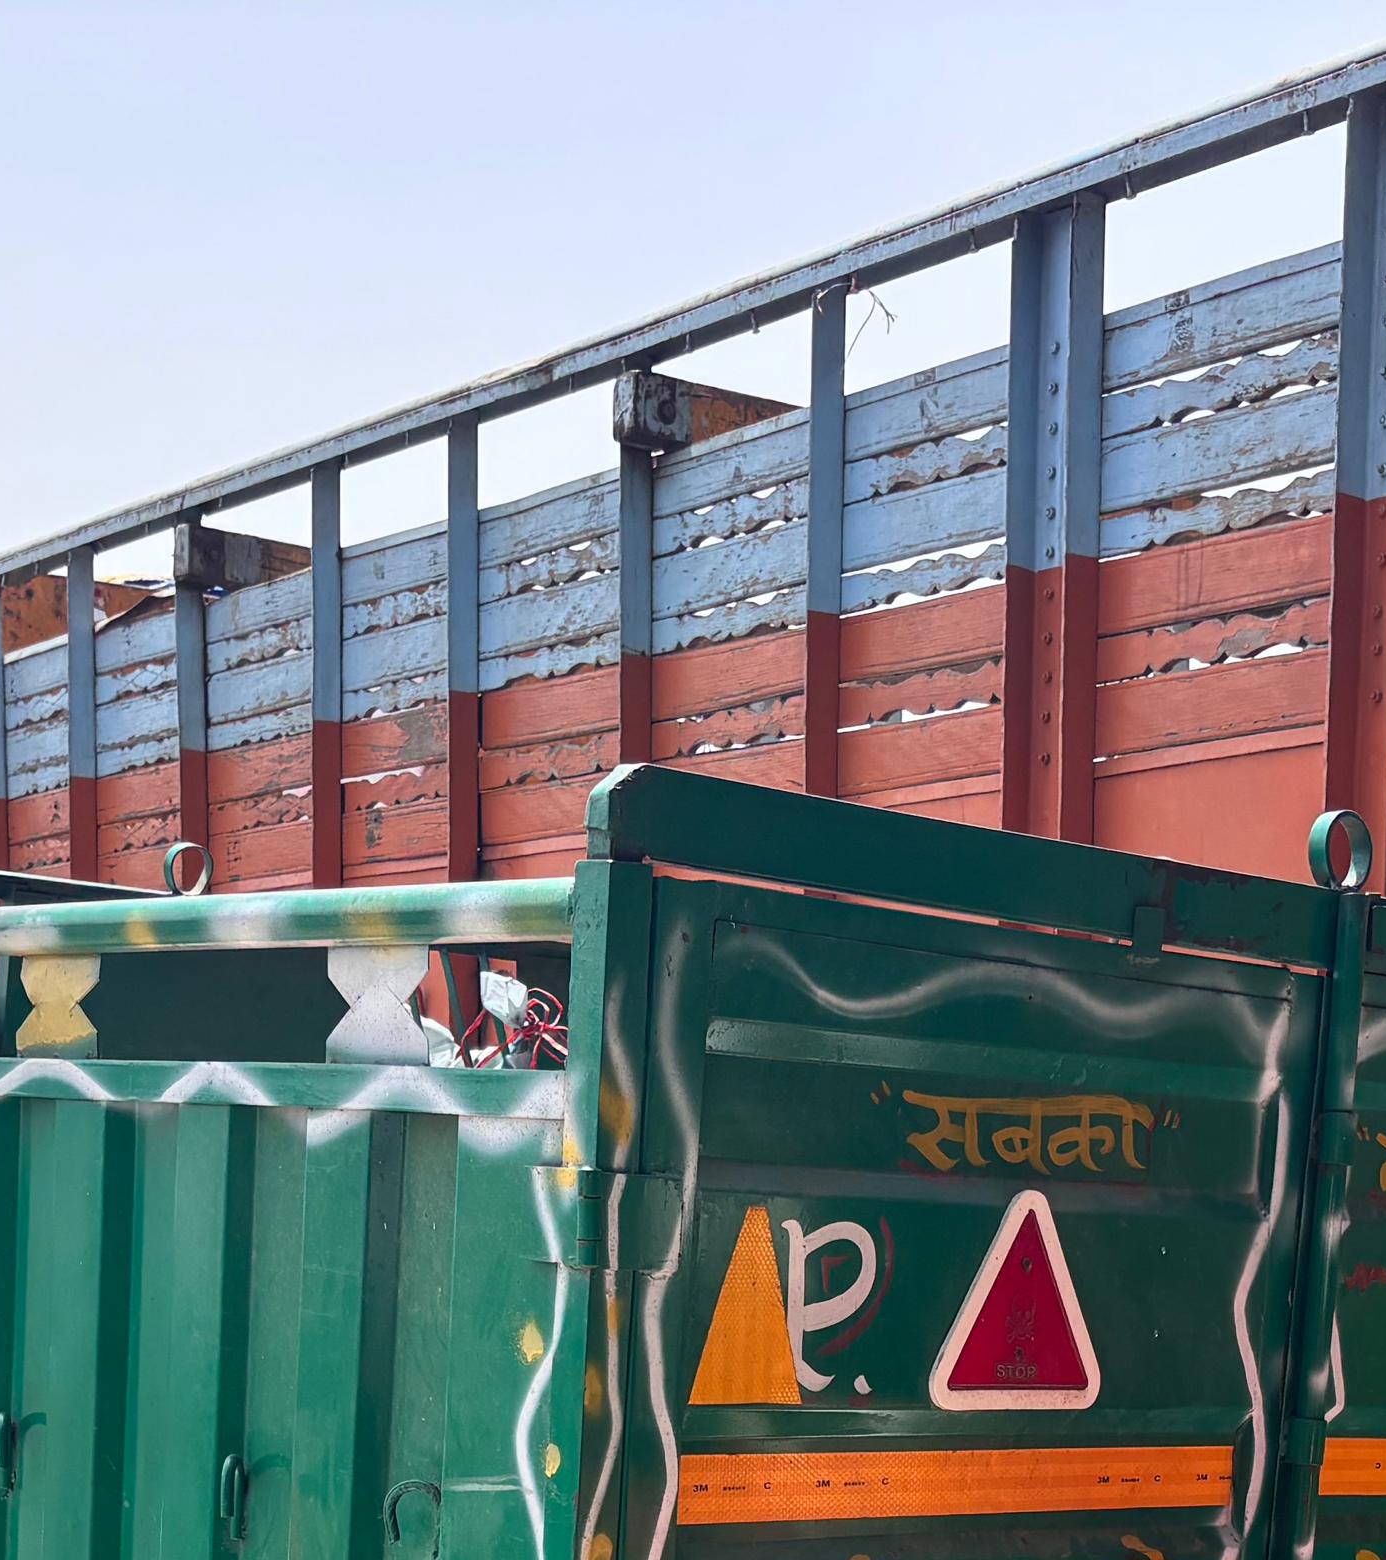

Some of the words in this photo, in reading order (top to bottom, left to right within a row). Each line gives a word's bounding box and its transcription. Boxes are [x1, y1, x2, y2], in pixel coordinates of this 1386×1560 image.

[995, 1363, 1038, 1380] STOP
[692, 1483, 709, 1493] 3M
[815, 1479, 831, 1489] 3M
